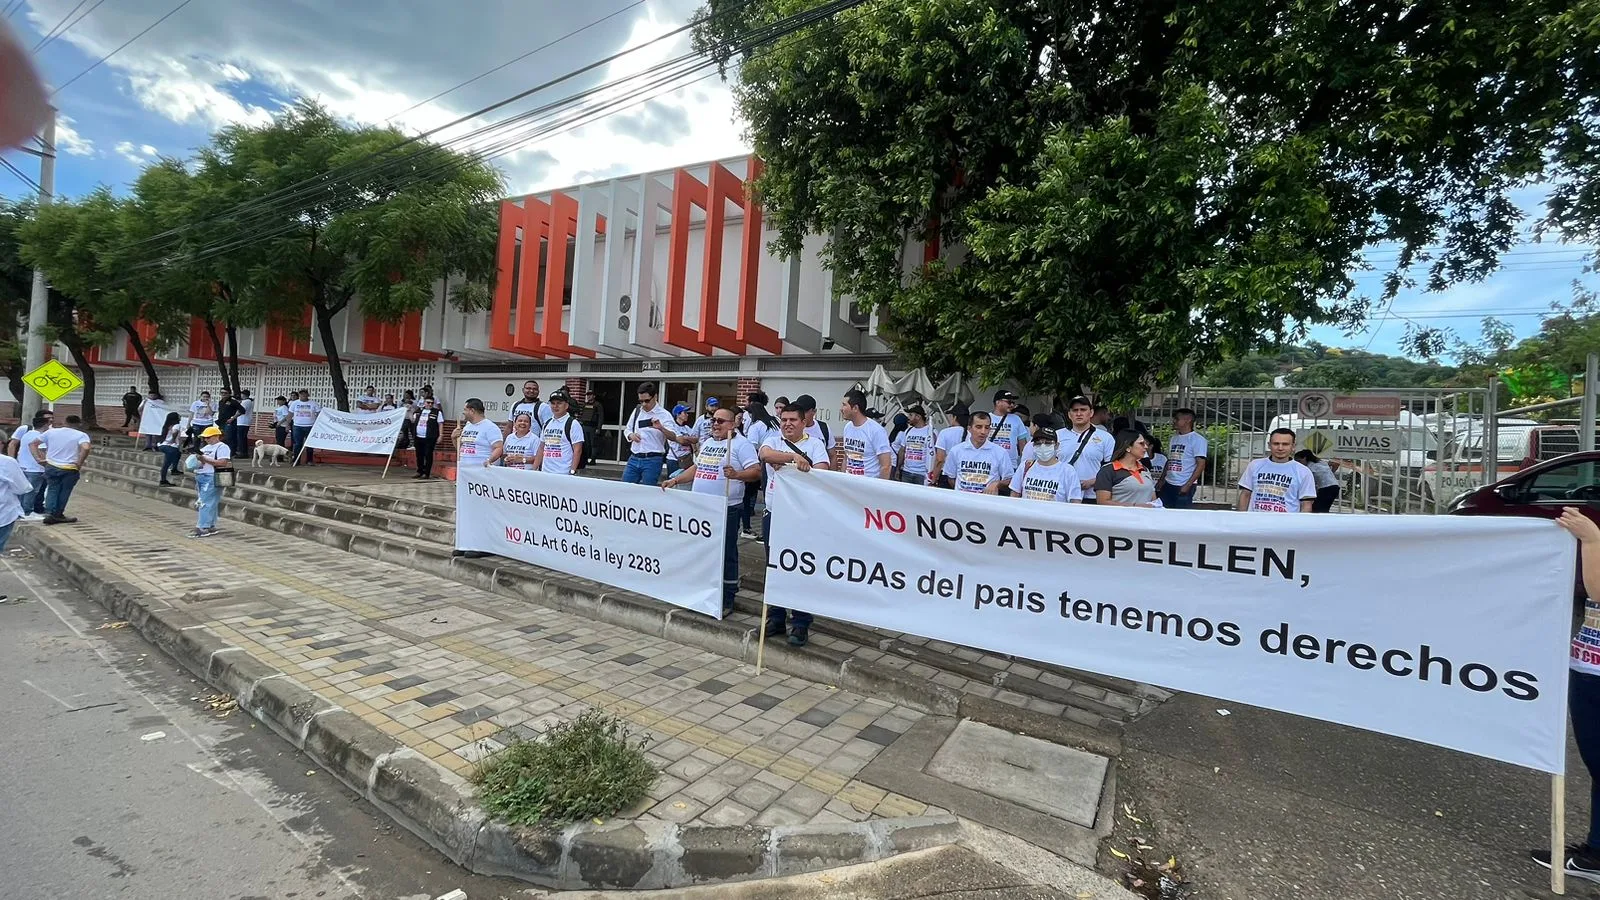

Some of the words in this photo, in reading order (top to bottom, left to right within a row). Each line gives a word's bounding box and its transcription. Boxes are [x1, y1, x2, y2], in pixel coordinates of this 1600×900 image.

[1336, 402, 1395, 410] MinTransporte
[1338, 436, 1391, 448] INVIAS
[961, 461, 992, 471] PLANTÓN
[1026, 477, 1059, 491] PLANTÓN
[1257, 472, 1293, 485] PLANTÓN
[468, 482, 490, 499] POR
[491, 486, 506, 502] LA
[508, 489, 577, 513] SEGURIDAD
[582, 500, 648, 526] JURÍDICA
[652, 511, 673, 531] DE
[678, 516, 712, 538] LOS
[556, 517, 593, 540] CDAs,
[506, 526, 522, 545] NO
[524, 530, 540, 547] AL
[542, 533, 558, 552] Art
[561, 538, 569, 554] 6
[571, 541, 586, 558] de
[590, 544, 601, 562] la
[605, 547, 623, 570] ley
[628, 553, 661, 576] 2283
[864, 508, 906, 534] NO
[916, 515, 987, 545] NOS
[997, 525, 1310, 589] ATROPELLEN,
[767, 545, 815, 576] LOS
[826, 556, 906, 591] CDAs
[917, 570, 963, 600] del
[974, 582, 1046, 614] pais
[1059, 590, 1242, 647] tenemos
[1260, 622, 1540, 701] derechos
[1582, 650, 1600, 665] CD
